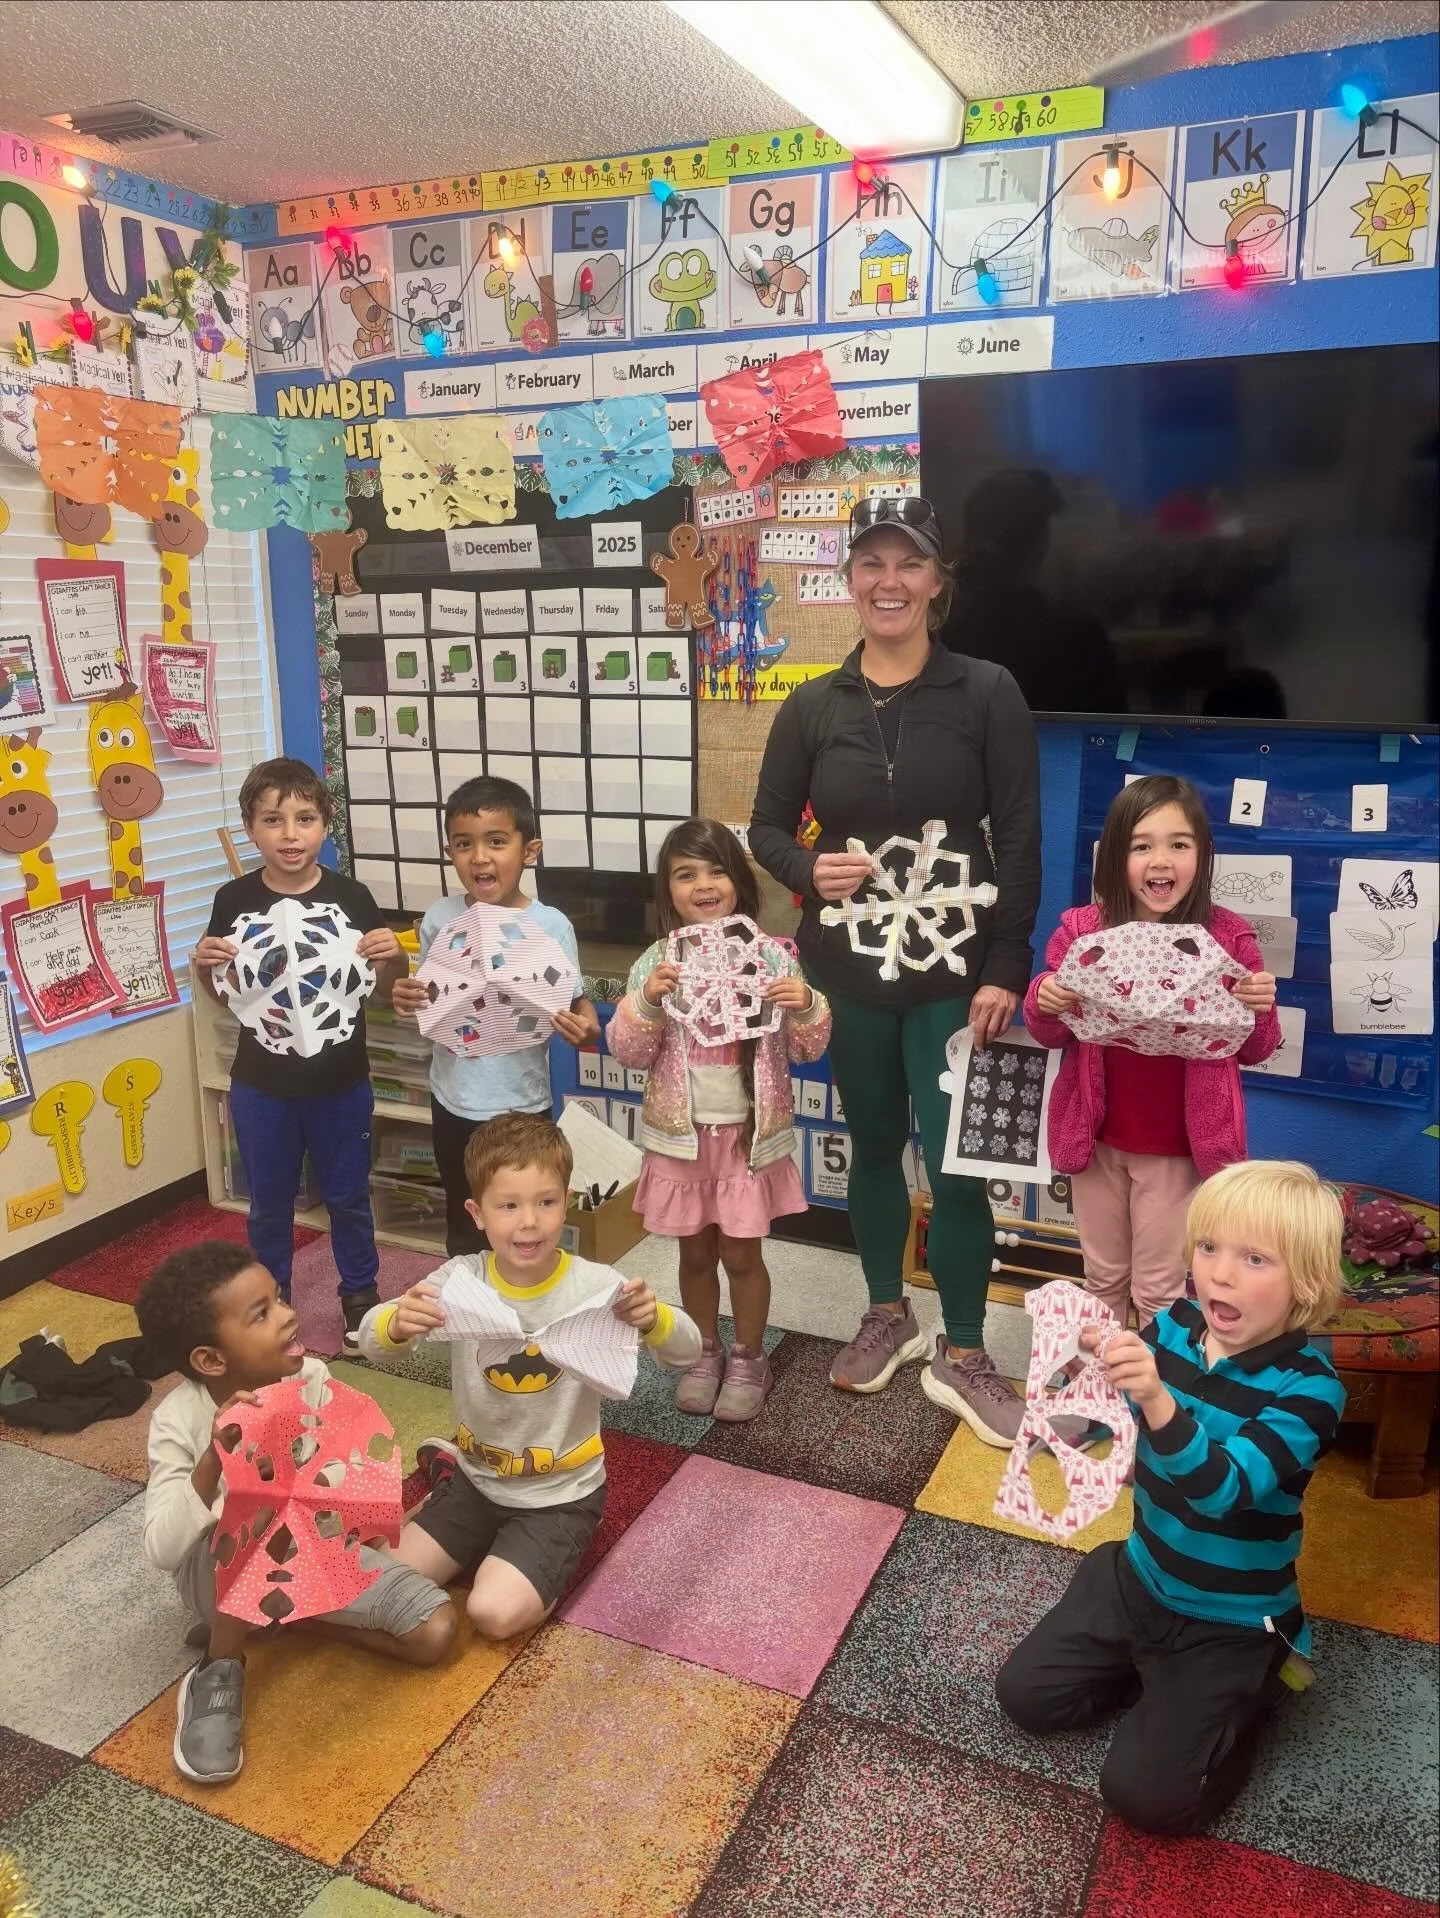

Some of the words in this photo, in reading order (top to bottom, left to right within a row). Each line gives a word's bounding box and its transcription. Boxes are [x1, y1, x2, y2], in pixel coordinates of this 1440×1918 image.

[965, 118, 983, 136] 57
[989, 111, 1009, 131] 58
[1037, 107, 1057, 128] 60
[725, 150, 737, 168] 51
[1212, 127, 1268, 176] Kk
[534, 176, 551, 196] 43
[561, 171, 576, 192] 44
[580, 169, 600, 191] 45
[601, 172, 616, 187] 46
[619, 170, 633, 186] 47
[641, 167, 653, 181] 48
[663, 166, 677, 182] 49
[692, 163, 706, 180] 50
[394, 193, 410, 213] 36
[414, 193, 428, 210] 37
[434, 192, 449, 208] 38
[453, 188, 469, 205] 39
[856, 175, 904, 220] Hh
[749, 188, 796, 237] Gg
[571, 210, 609, 250] Ee
[409, 232, 446, 269] Cc
[338, 242, 373, 281] Bb
[264, 255, 299, 288] Aa
[976, 336, 1021, 355] June
[854, 346, 890, 366] May
[79, 360, 110, 382] Magical
[628, 362, 675, 380] March
[429, 381, 481, 398] January
[517, 371, 581, 392] February
[276, 378, 396, 421] NUMBER
[837, 401, 912, 422] ovember
[758, 494, 771, 508] 10
[840, 495, 857, 510] 20
[465, 540, 533, 557] December
[597, 536, 637, 553] 2025
[820, 540, 838, 554] 40
[344, 609, 369, 619] Sunday
[389, 609, 416, 619] Monday
[439, 604, 468, 615] Tuesday
[484, 605, 525, 617] Wednesday
[539, 605, 574, 615] Thursday
[595, 604, 620, 615] Friday
[82, 662, 113, 685] yet!
[422, 679, 427, 689] 1
[471, 678, 477, 688] 2
[520, 682, 526, 691] 3
[569, 680, 576, 690] 4
[628, 681, 635, 691] 5
[680, 682, 687, 692] 6
[379, 736, 385, 745] 7
[422, 737, 428, 747] 8
[1240, 802, 1252, 816] 2
[1363, 807, 1374, 821] 3
[122, 974, 151, 997] yet!
[126, 1075, 134, 1091] S
[584, 1069, 597, 1080] 10
[608, 1072, 618, 1083] 11
[632, 1073, 645, 1085] 12
[53, 1101, 68, 1119] R
[807, 1097, 821, 1110] 19
[129, 1124, 139, 1160] PRESENT
[59, 1117, 81, 1186] RESPONSIBILITY
[822, 1136, 847, 1174] 5
[11, 1199, 55, 1223] Keys
